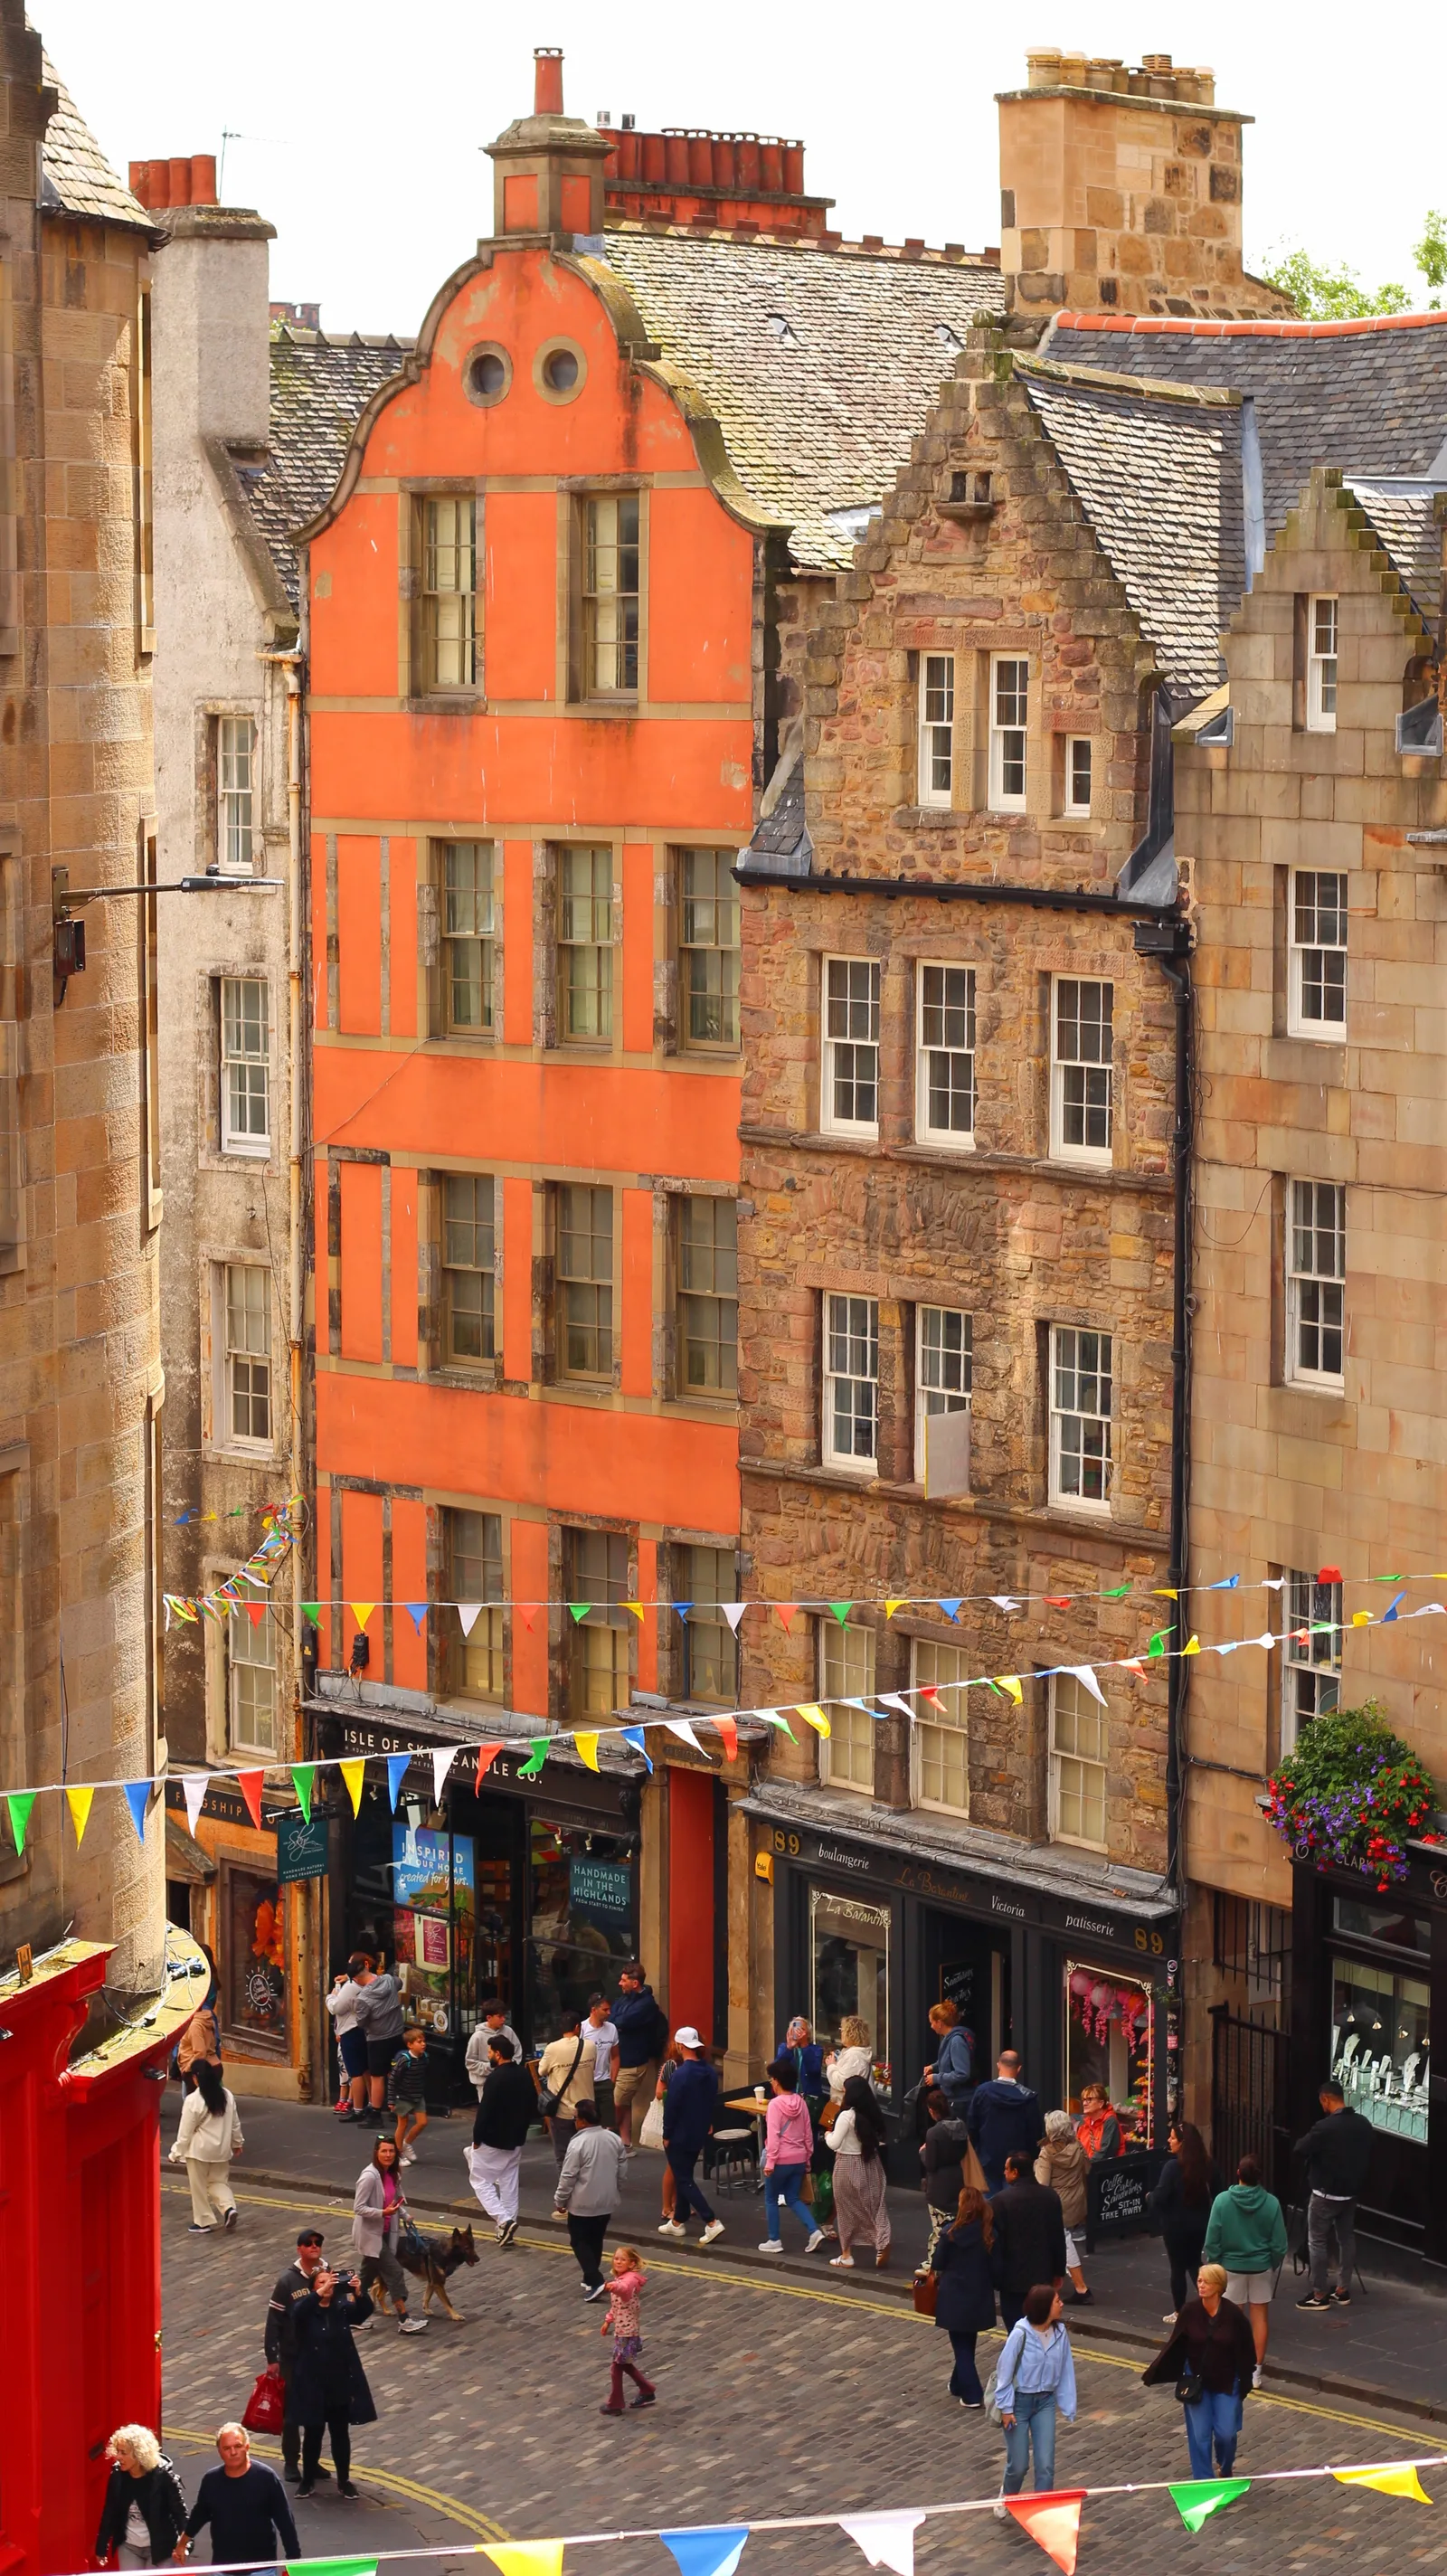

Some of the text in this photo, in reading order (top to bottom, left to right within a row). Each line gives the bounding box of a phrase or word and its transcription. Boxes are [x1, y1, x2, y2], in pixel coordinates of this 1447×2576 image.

[345, 1728, 374, 1747] ISLE
[381, 1738, 400, 1752] OF
[774, 1830, 799, 1855] 89
[818, 1842, 870, 1870] boulangerie
[574, 1865, 626, 1883] HANDMADE
[756, 1863, 767, 1872] Yale
[399, 1870, 430, 1883] created
[430, 1872, 447, 1886] for
[583, 1878, 614, 1892] IN THE
[573, 1887, 627, 1906] HIGHLANDS
[827, 1899, 841, 1916] La
[991, 1895, 1025, 1917] Victoria
[1065, 1915, 1114, 1936] patisserie
[1134, 1927, 1163, 1955] 89
[1118, 2198, 1140, 2209] SIT-IN
[1101, 2205, 1142, 2221] TAKE AWAY
